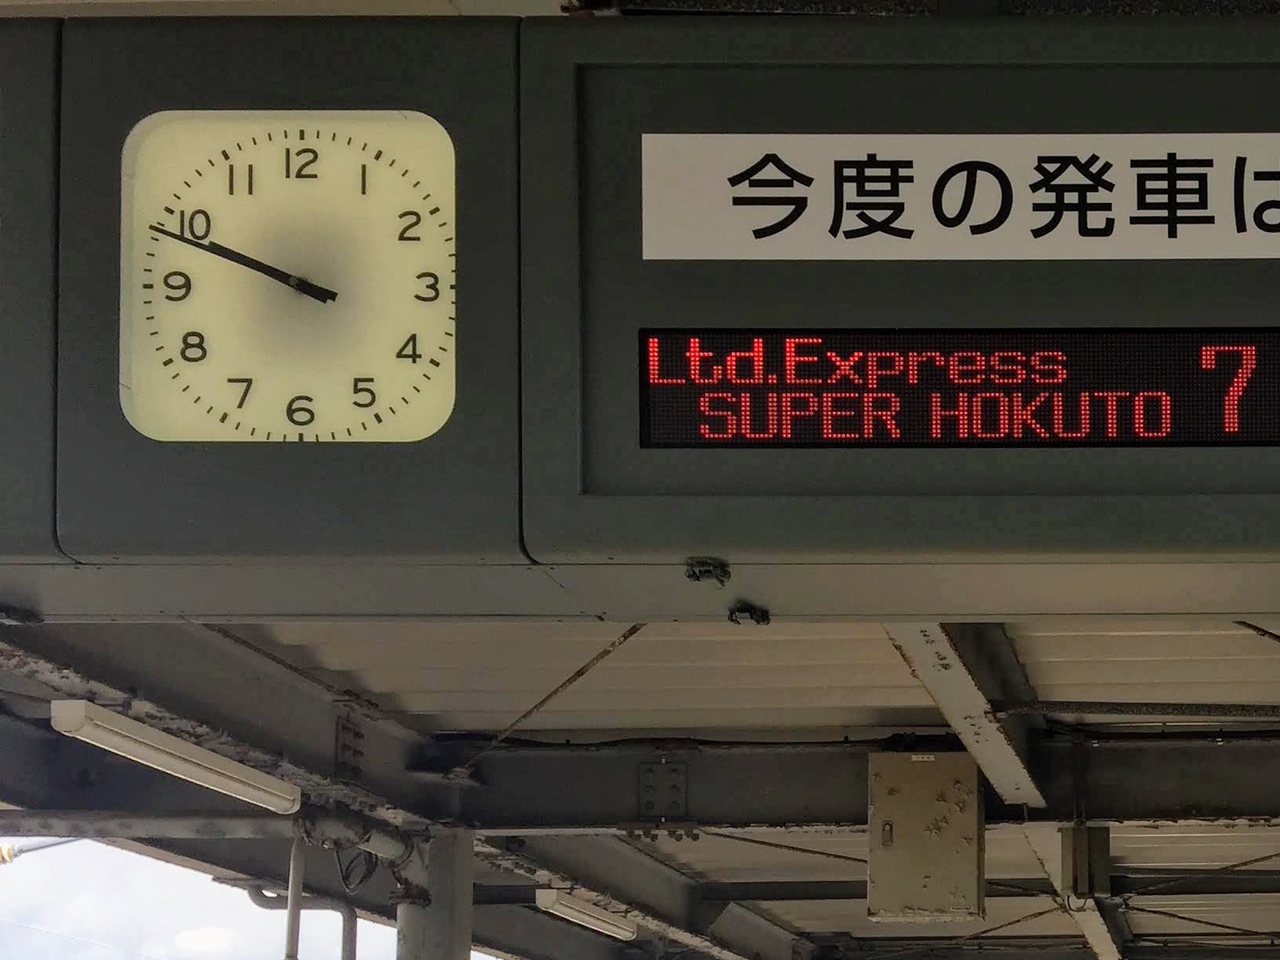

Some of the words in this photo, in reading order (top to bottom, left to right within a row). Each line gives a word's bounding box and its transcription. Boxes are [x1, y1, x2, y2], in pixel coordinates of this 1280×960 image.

[286, 148, 318, 178] 12
[229, 165, 252, 195] 11
[361, 164, 367, 195] 1
[179, 210, 211, 240] 10
[398, 211, 421, 241] 2
[163, 271, 191, 301] 9
[414, 272, 439, 302] 3
[181, 332, 207, 362] 8
[396, 334, 421, 363] 4
[649, 338, 1066, 388] Ltd.Express
[228, 379, 252, 408] 7
[353, 378, 376, 407] 5
[1202, 346, 1256, 431] 7
[286, 396, 314, 426] 6
[700, 393, 900, 438] SUPER
[932, 392, 1170, 437] HOKUTO
